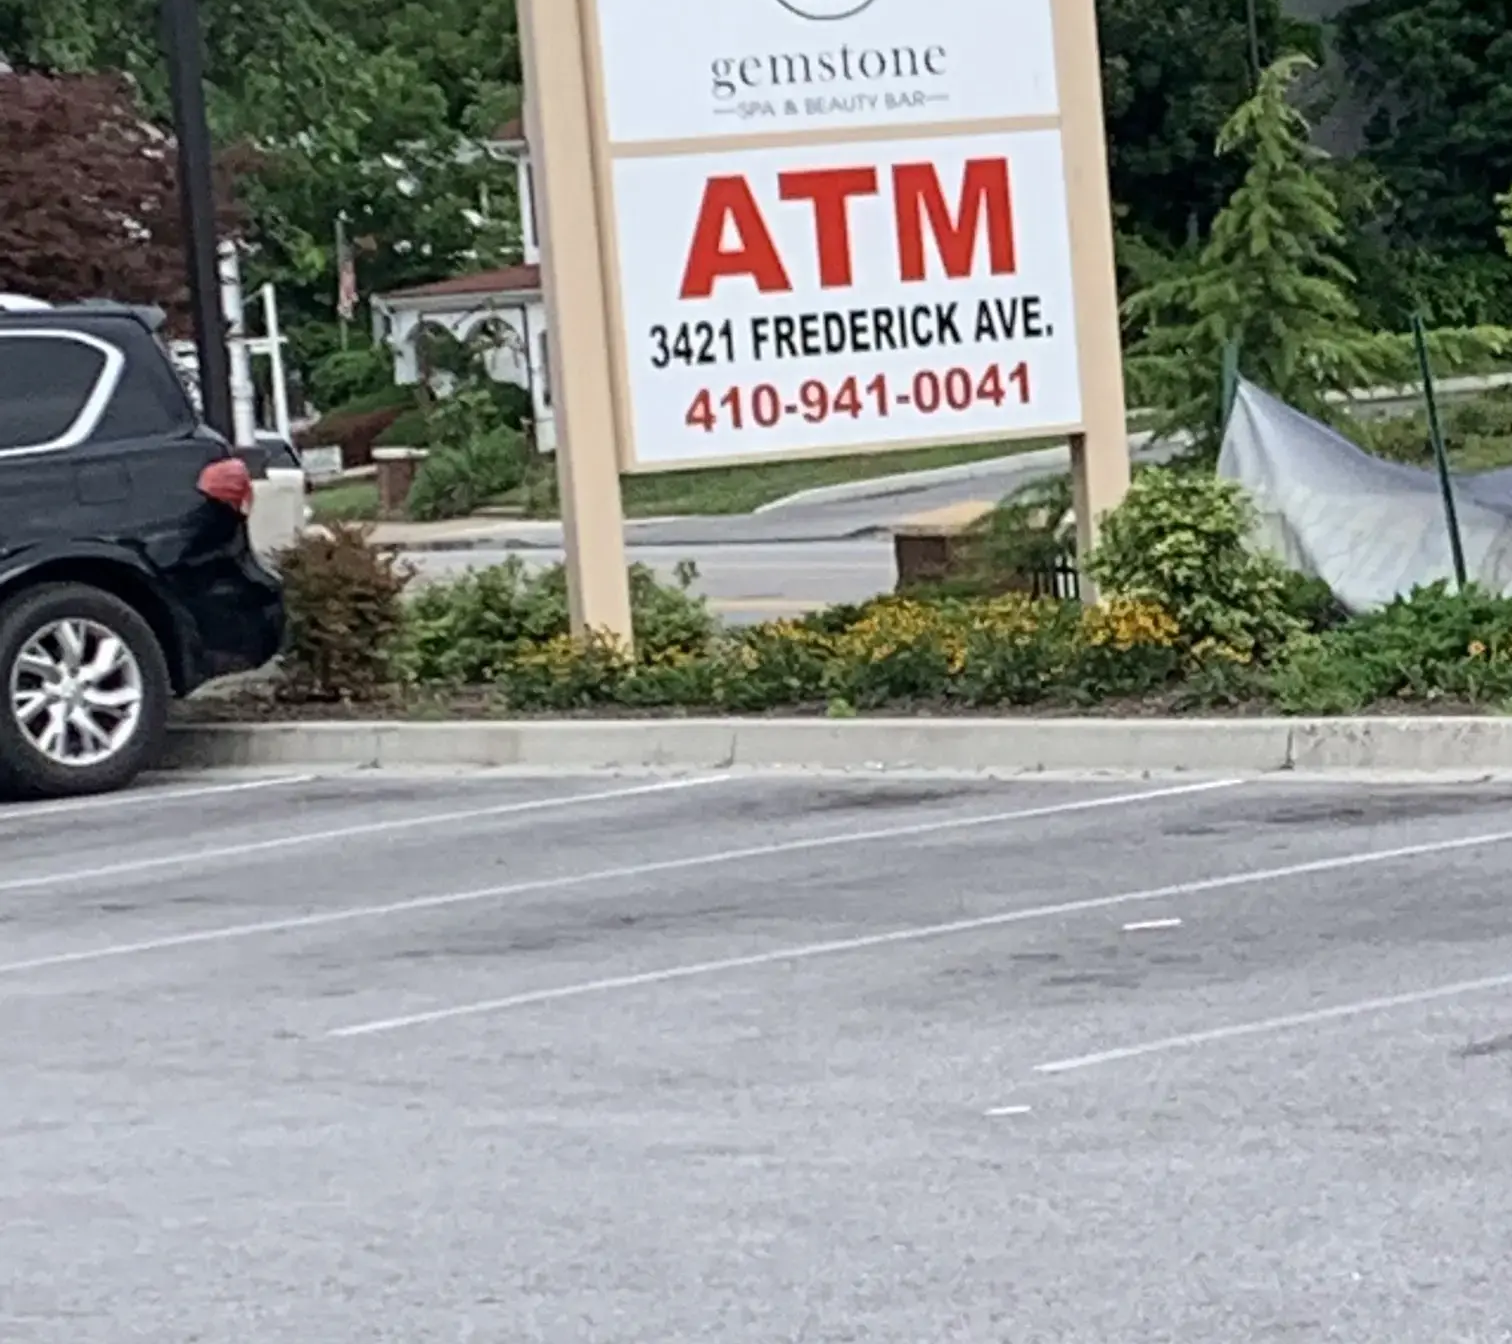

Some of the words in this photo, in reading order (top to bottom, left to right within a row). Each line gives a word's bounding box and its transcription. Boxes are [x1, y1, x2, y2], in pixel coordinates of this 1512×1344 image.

[710, 44, 947, 100] gemstone
[804, 93, 879, 116] BEAUTY
[885, 90, 926, 110] BAR
[678, 156, 1018, 301] ATM
[650, 318, 735, 369] 3421
[751, 301, 963, 360] FREDERICK
[973, 295, 1054, 343] AVE.
[684, 361, 1031, 433] 410-941-0041
